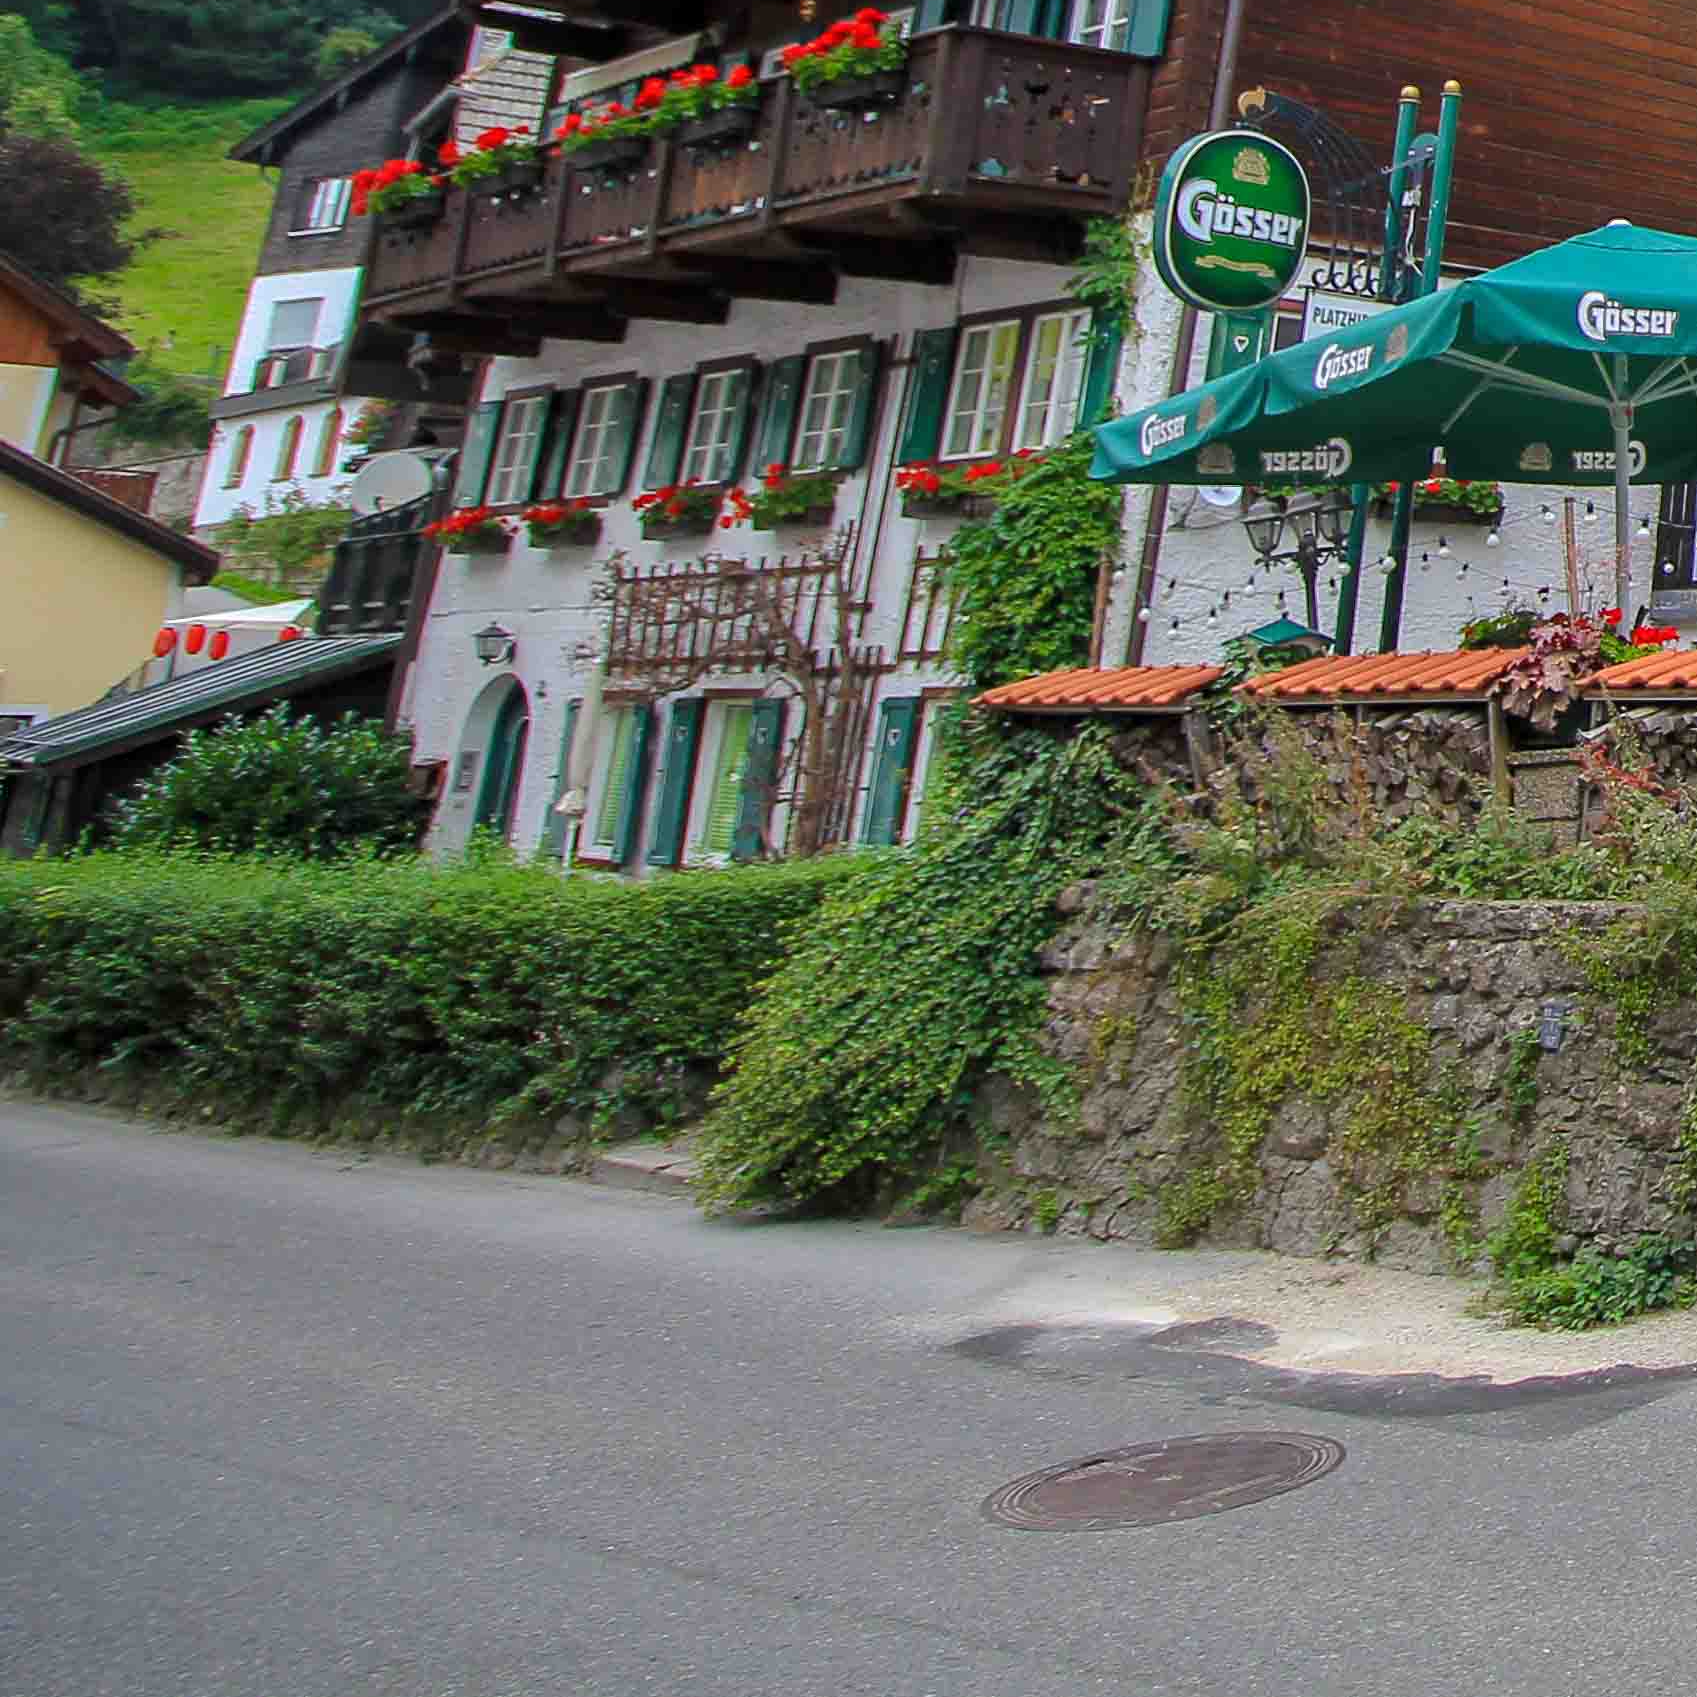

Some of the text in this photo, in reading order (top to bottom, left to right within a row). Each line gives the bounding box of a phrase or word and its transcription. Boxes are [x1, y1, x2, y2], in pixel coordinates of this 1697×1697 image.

[1176, 178, 1303, 247] Gösser
[1577, 290, 1678, 341] Gösser
[1314, 344, 1374, 389] Gösser
[1140, 414, 1186, 456] Gösser
